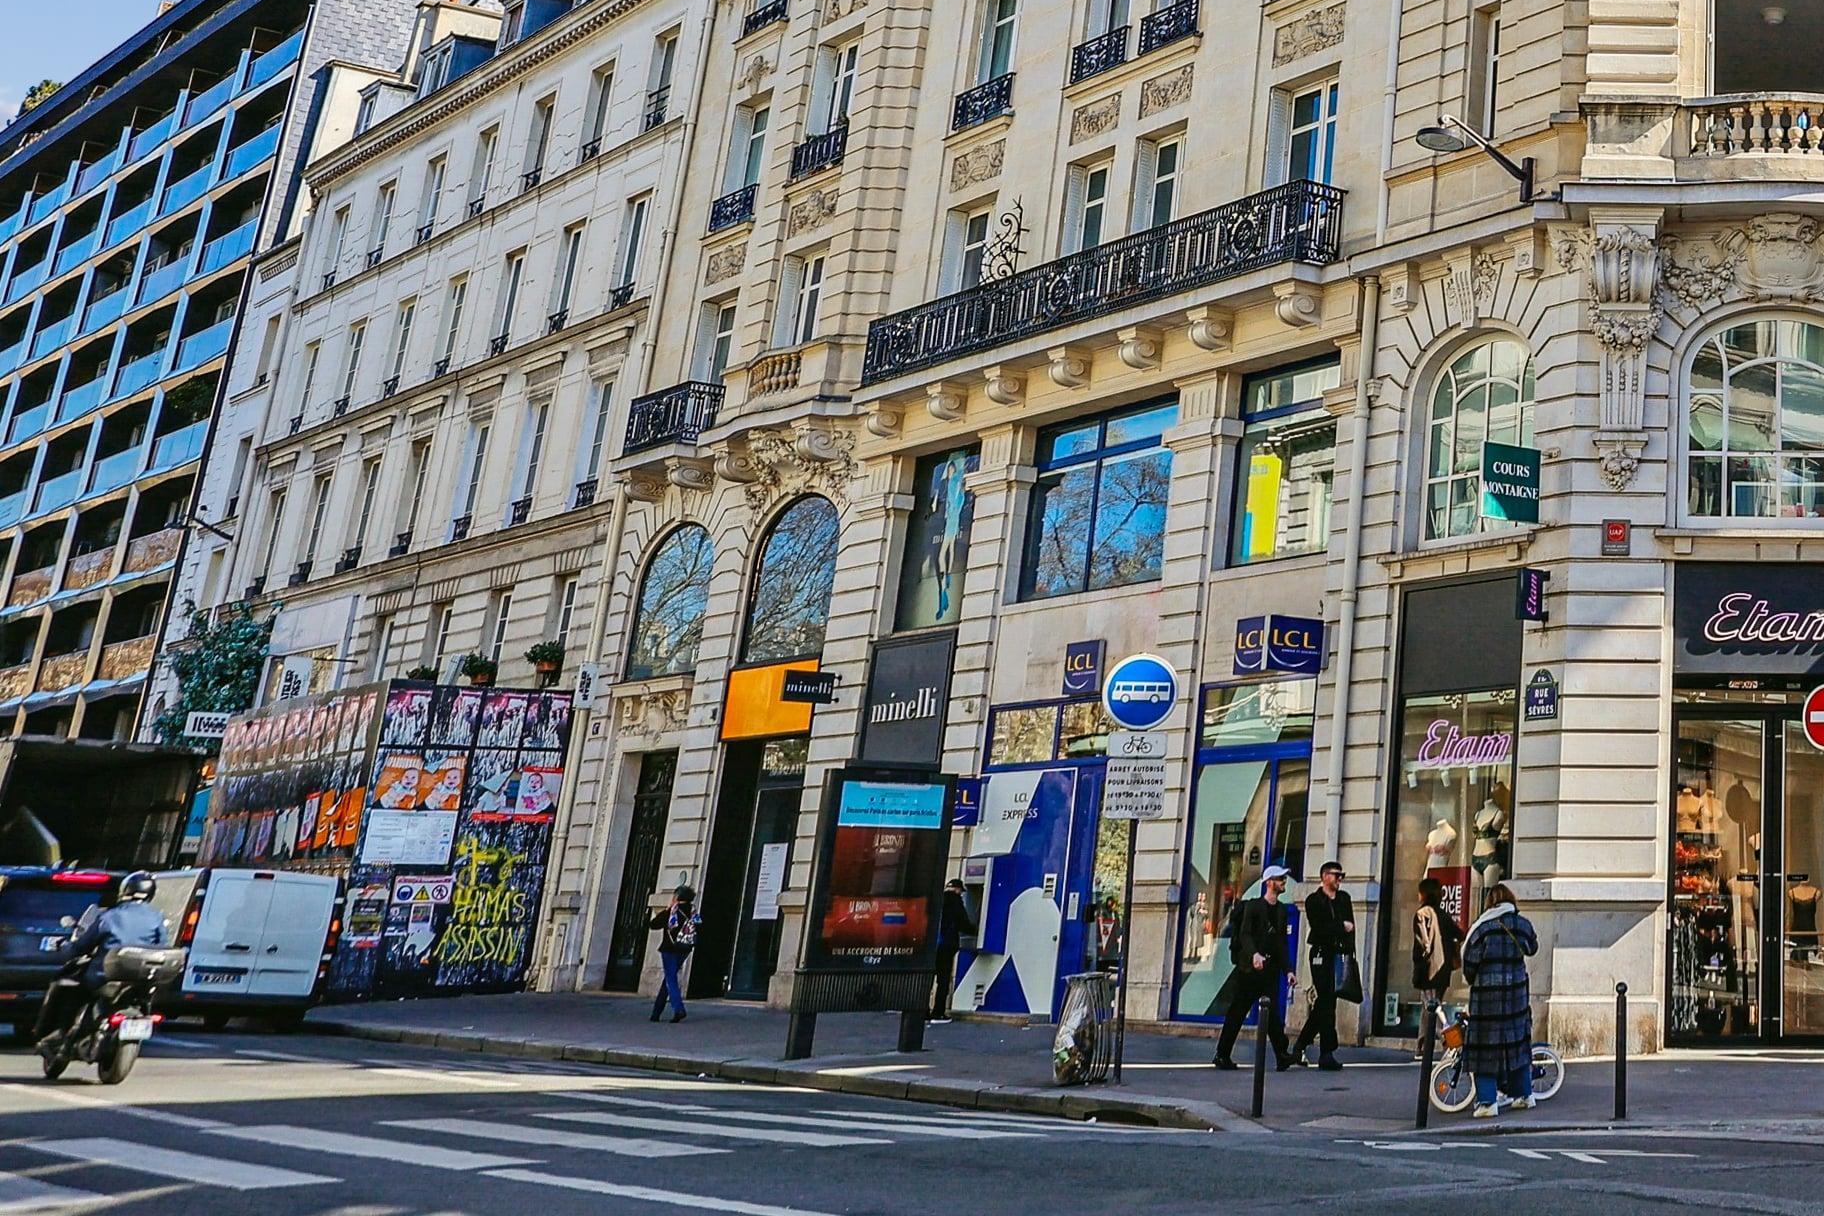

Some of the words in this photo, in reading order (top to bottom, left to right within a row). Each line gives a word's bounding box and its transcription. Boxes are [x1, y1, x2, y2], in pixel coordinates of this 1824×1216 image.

[1492, 461, 1530, 478] COURS
[1483, 481, 1539, 501] MONTAIGNE
[1526, 573, 1539, 616] Etam
[1273, 628, 1317, 650] LCL
[1067, 653, 1094, 672] LCL
[785, 680, 832, 695] minelli
[1534, 688, 1549, 698] RUE
[870, 687, 937, 723] minelli
[1418, 719, 1512, 766] Etam
[1441, 885, 1462, 901] OVE
[1440, 901, 1462, 914] RICE
[433, 923, 525, 965] ASSASSIN
